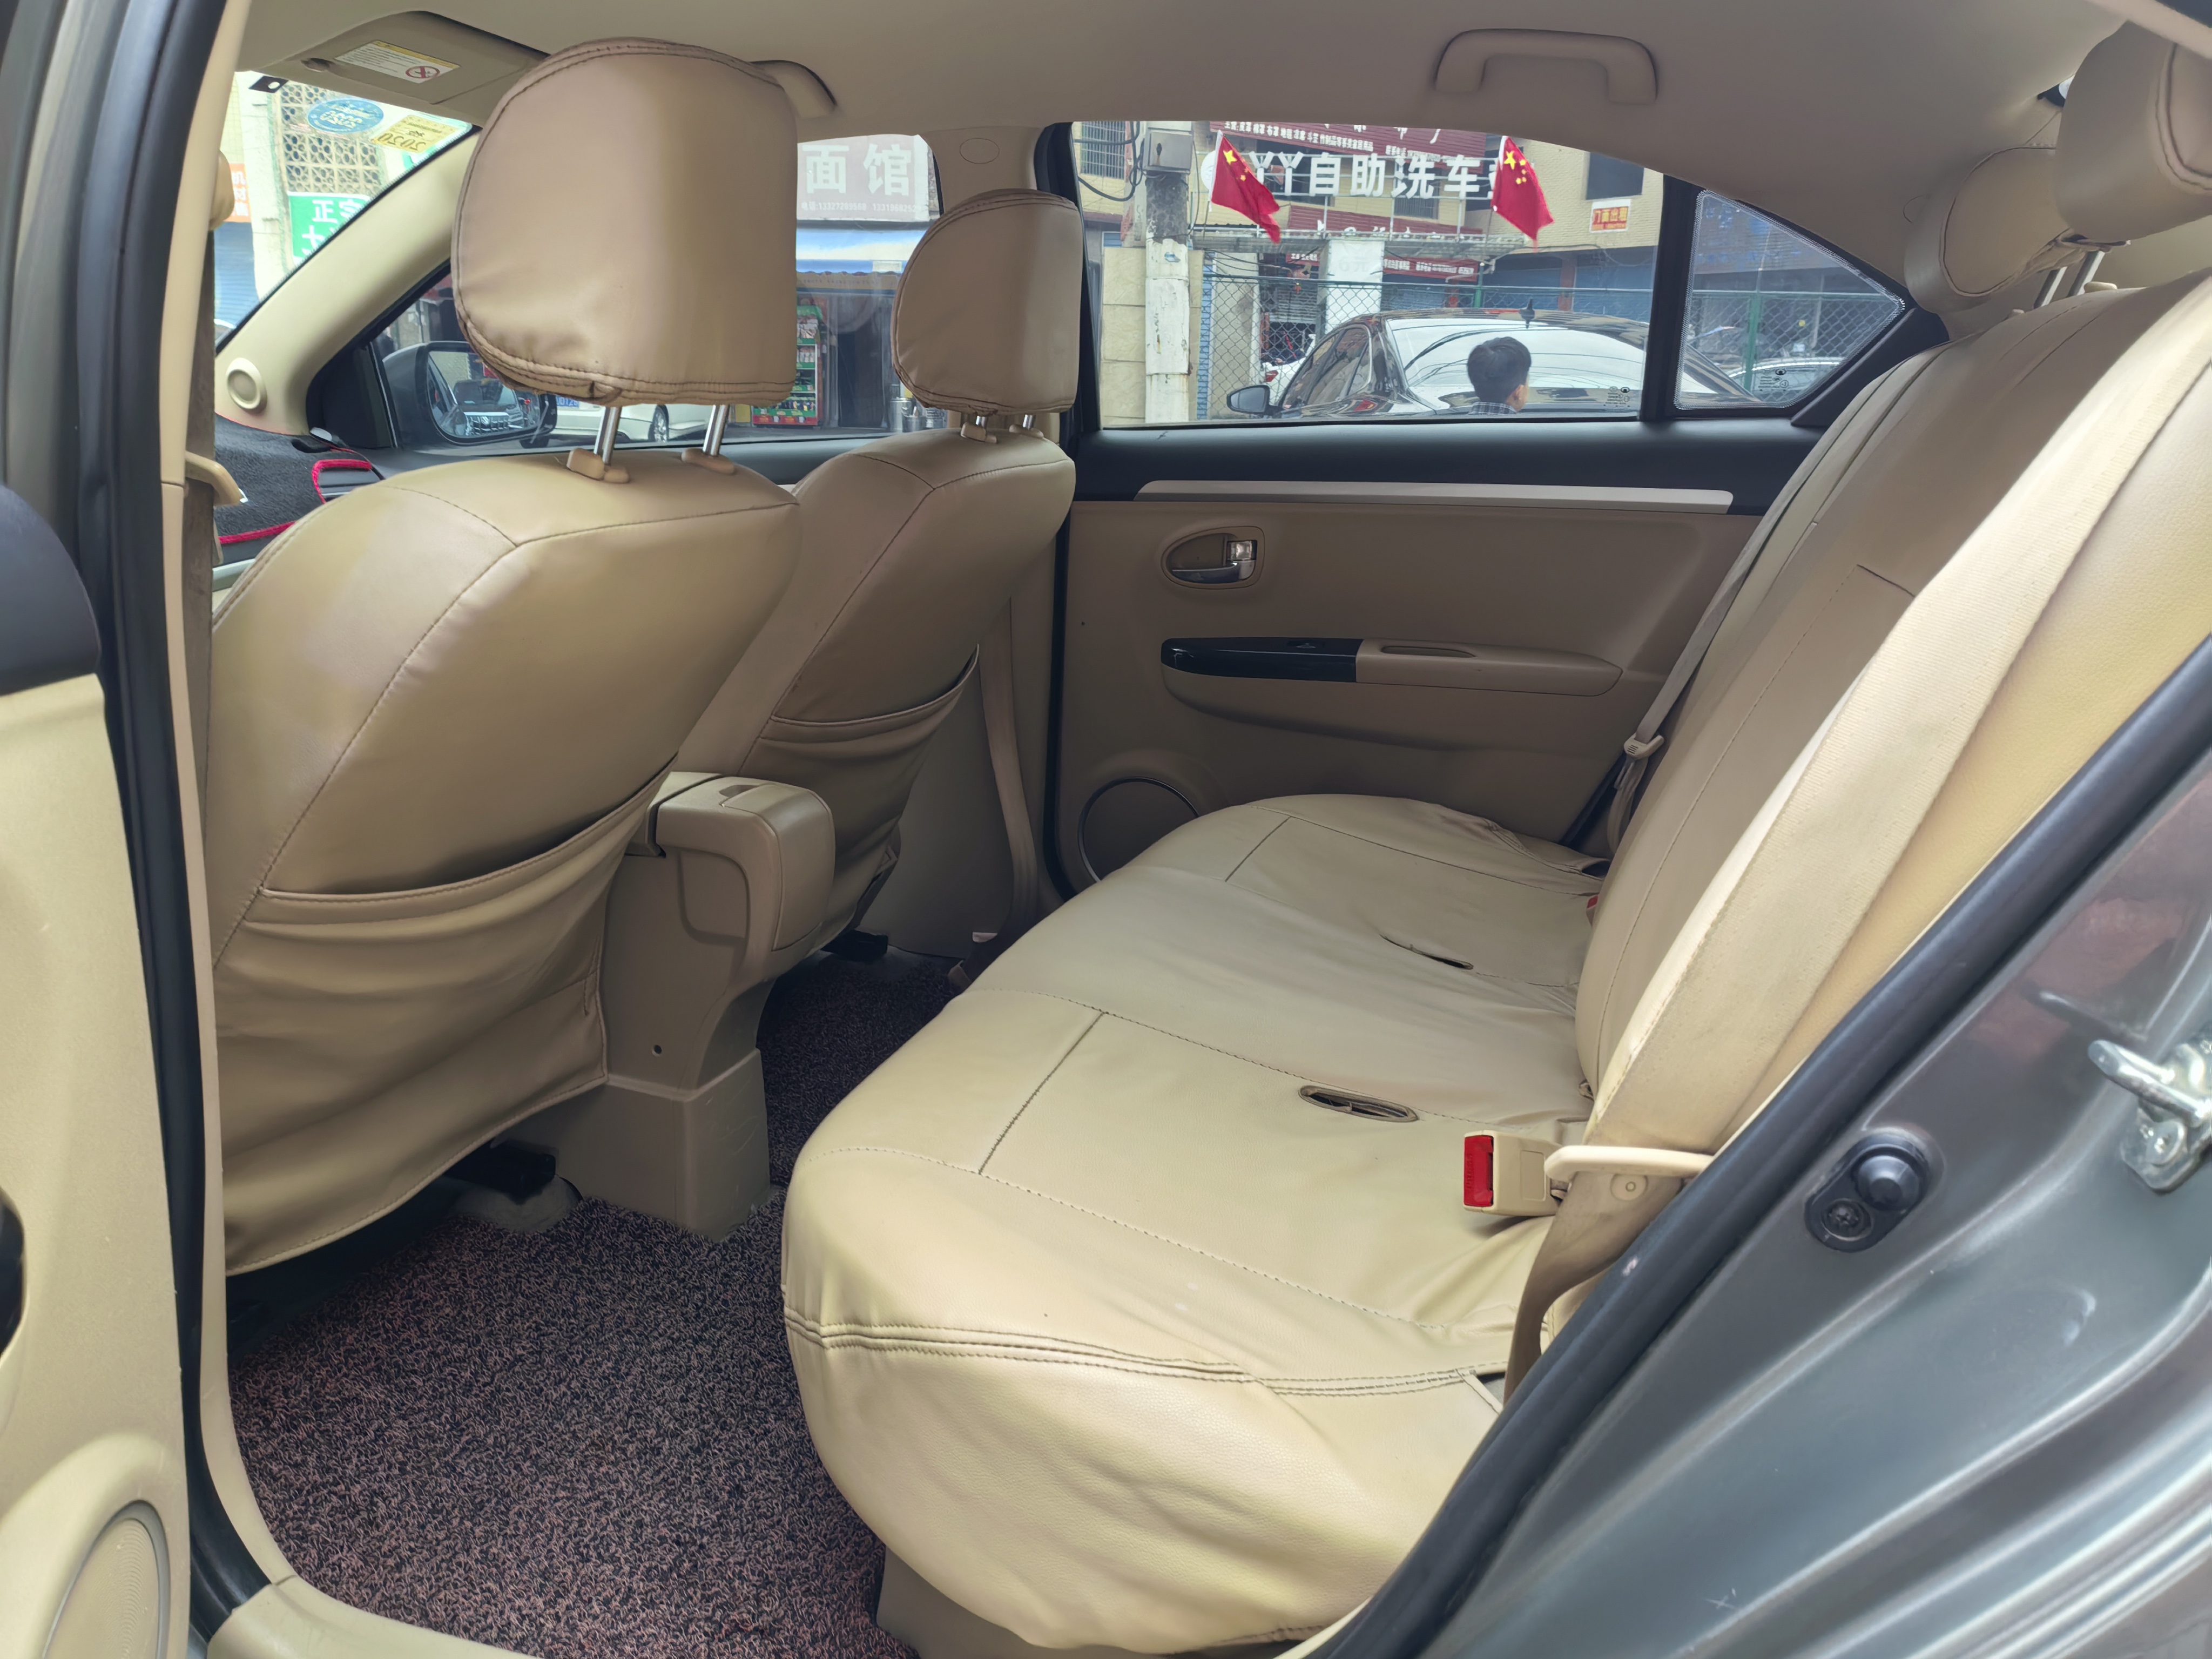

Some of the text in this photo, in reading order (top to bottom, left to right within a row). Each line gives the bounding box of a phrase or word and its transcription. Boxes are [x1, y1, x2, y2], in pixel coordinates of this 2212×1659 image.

[802, 143, 912, 196] 面馆
[1249, 151, 1498, 199] YY自助洗车
